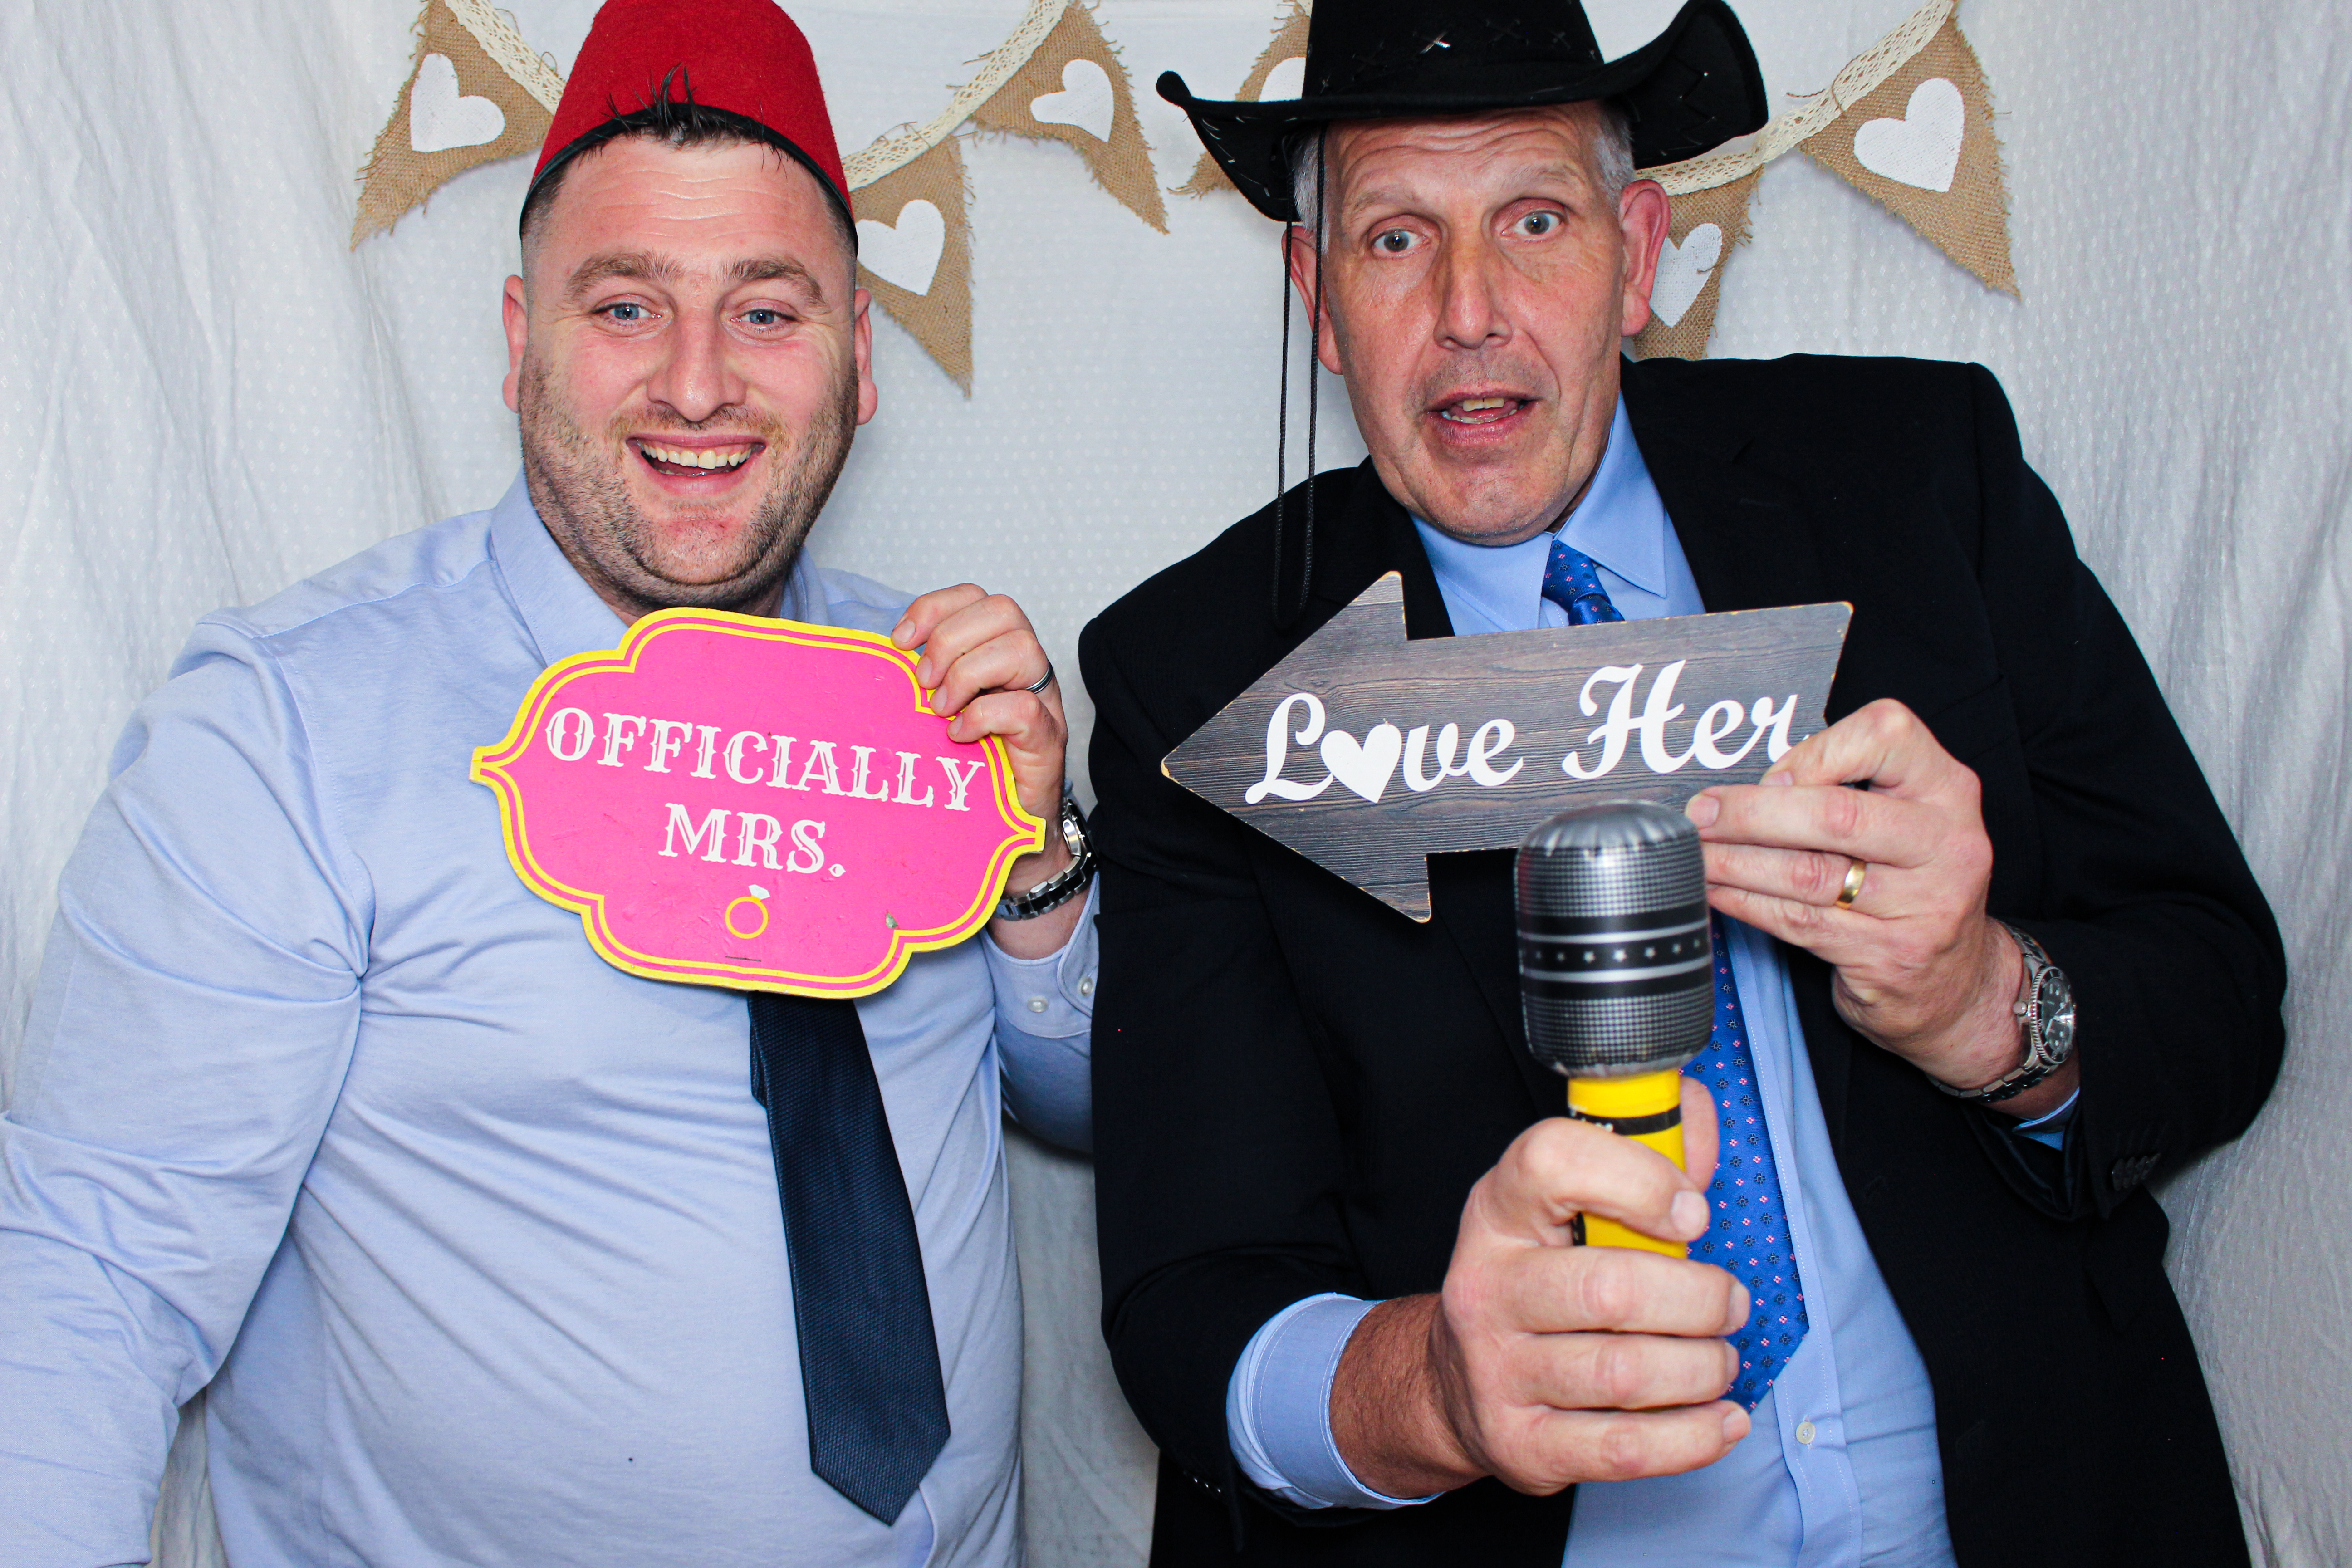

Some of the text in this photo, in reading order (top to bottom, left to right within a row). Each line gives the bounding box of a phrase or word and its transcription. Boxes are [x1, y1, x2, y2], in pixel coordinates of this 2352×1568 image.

[544, 707, 985, 811] OFFICIALLY
[1562, 659, 1809, 780] Her
[658, 803, 847, 877] MRS.
